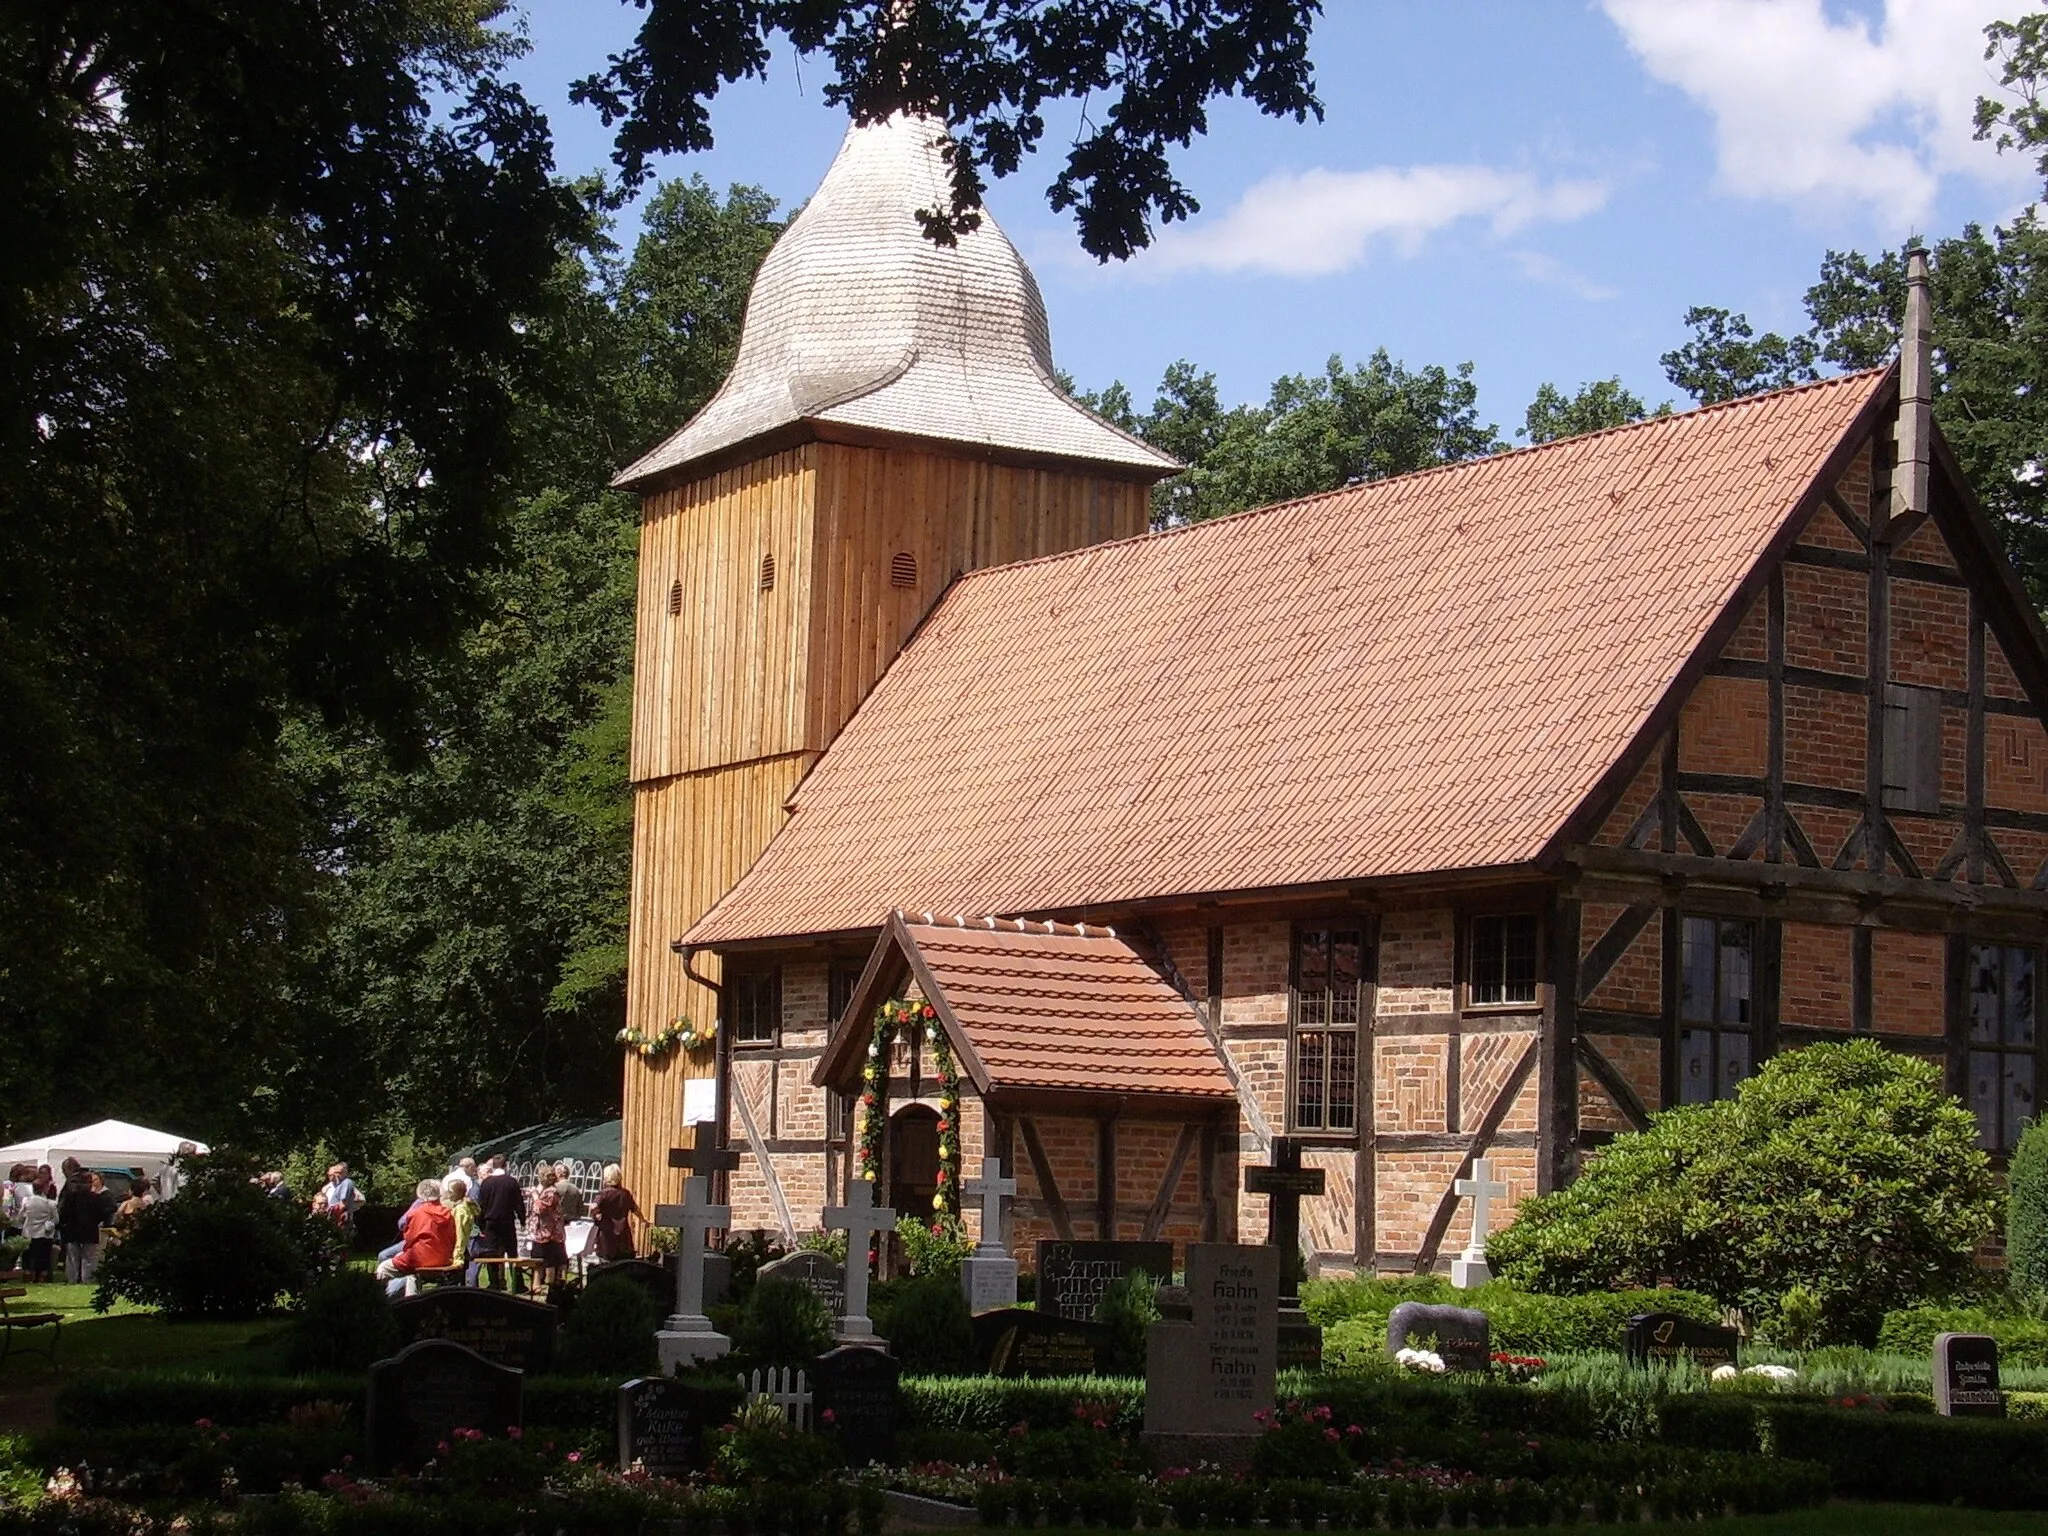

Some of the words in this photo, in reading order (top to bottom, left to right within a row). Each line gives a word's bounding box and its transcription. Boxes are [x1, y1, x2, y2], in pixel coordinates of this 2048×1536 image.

[1219, 1264, 1254, 1278] Frieda
[1213, 1280, 1258, 1299] Hahn
[1211, 1356, 1257, 1375] Hahn
